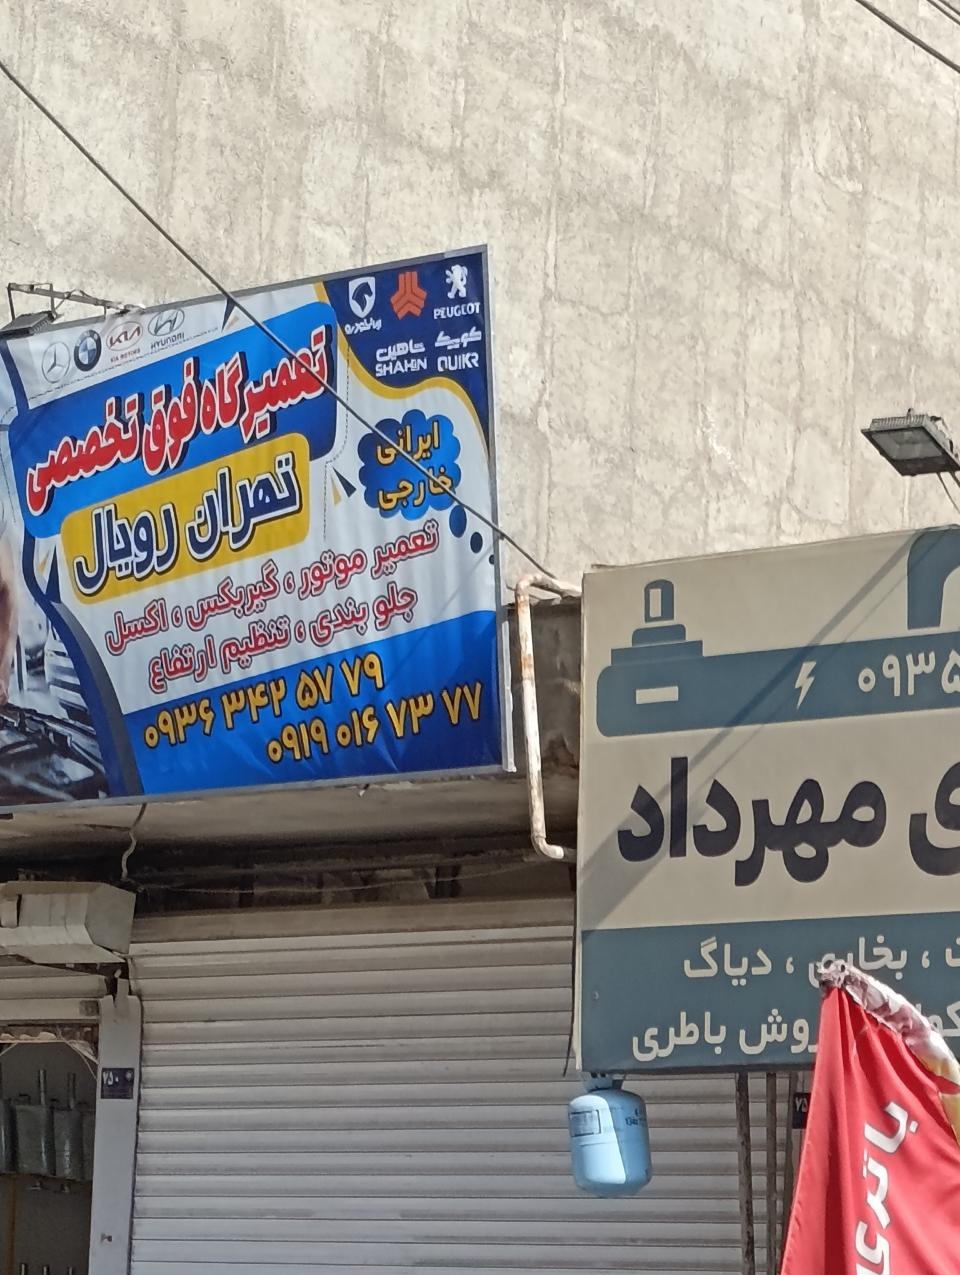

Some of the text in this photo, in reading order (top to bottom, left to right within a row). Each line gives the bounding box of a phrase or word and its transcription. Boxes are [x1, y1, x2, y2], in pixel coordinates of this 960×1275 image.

[433, 302, 481, 320] PEUGEOT
[151, 333, 185, 349] HYUNDAI
[375, 357, 428, 377] SHAHIN
[142, 357, 199, 476] فوق
[26, 394, 142, 515] تخصصی
[377, 420, 441, 466] ایرانی
[378, 463, 453, 512] خارجی
[73, 452, 302, 593] تهران رویال
[299, 549, 366, 599] موتور
[372, 518, 440, 579] تعمیر
[185, 559, 279, 631] گیربکس
[372, 582, 419, 630] جلو
[105, 598, 169, 656] اکسل
[221, 614, 291, 673] تنظیم
[310, 598, 369, 648] بندی
[148, 635, 217, 694] ارتفاع
[144, 652, 385, 748] ۰۹۳۶ ۳۴۲ ۵۷ ۷۹
[266, 681, 484, 763] ۰۹۱۹ ۰۱۶ ۷۳ ۷۷
[617, 756, 888, 888] مهرداد
[683, 936, 773, 986] دیاگ
[632, 1010, 727, 1061] باطری
[738, 1008, 818, 1056] وش
[795, 1096, 809, 1113] ۷۵
